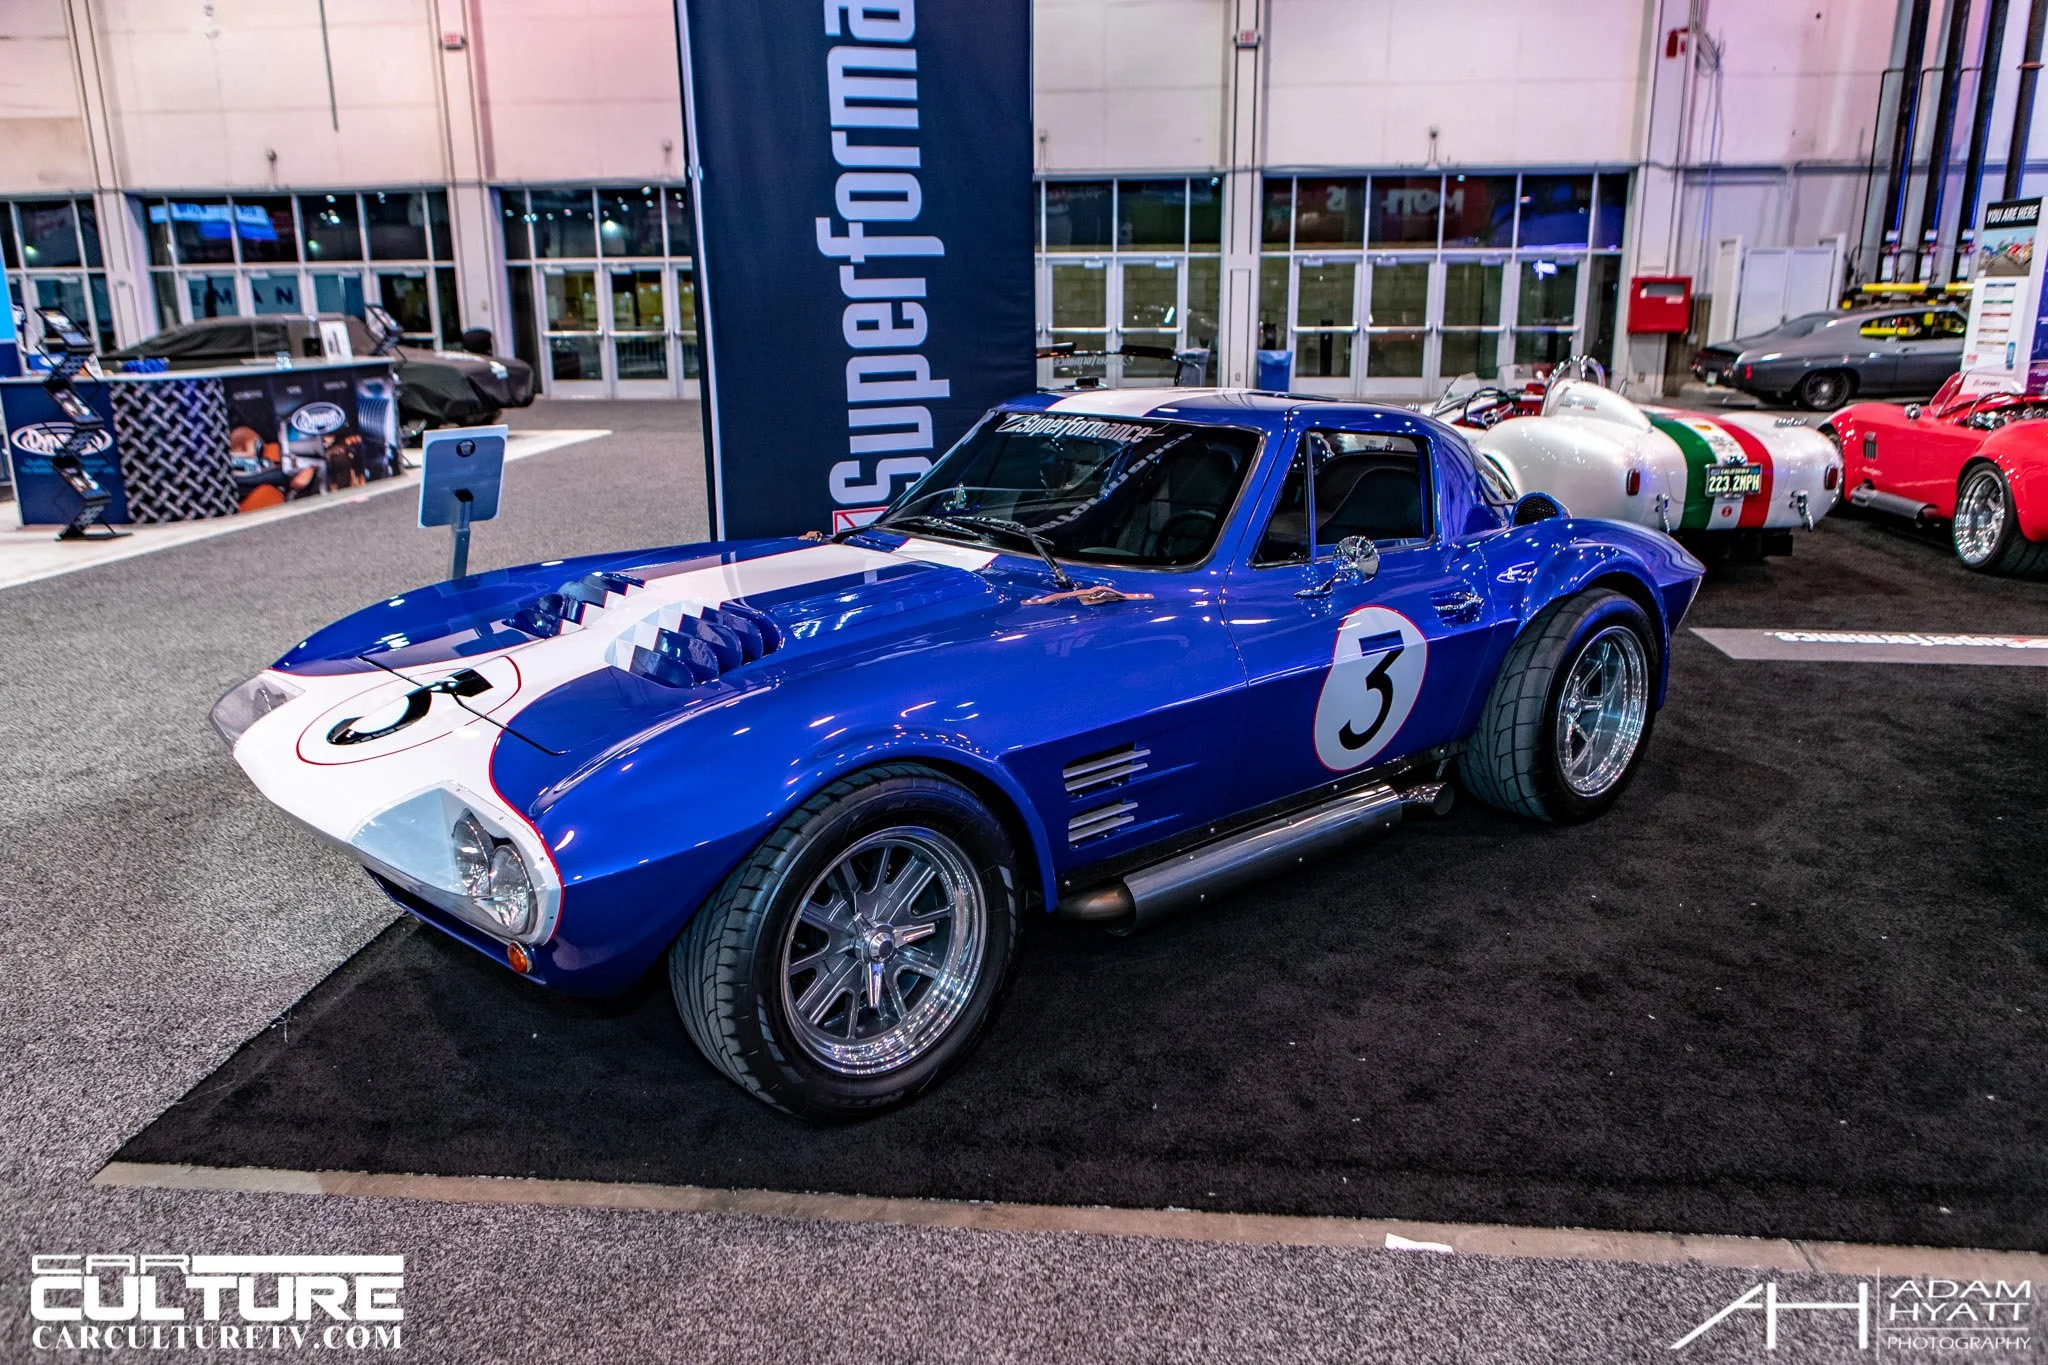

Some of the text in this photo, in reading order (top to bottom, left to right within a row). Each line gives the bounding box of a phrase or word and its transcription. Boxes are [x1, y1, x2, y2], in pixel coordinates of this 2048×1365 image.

[1987, 204, 2040, 223] YOU ARE HERE
[1019, 415, 1153, 443] Superformance
[1338, 629, 1405, 750] 3
